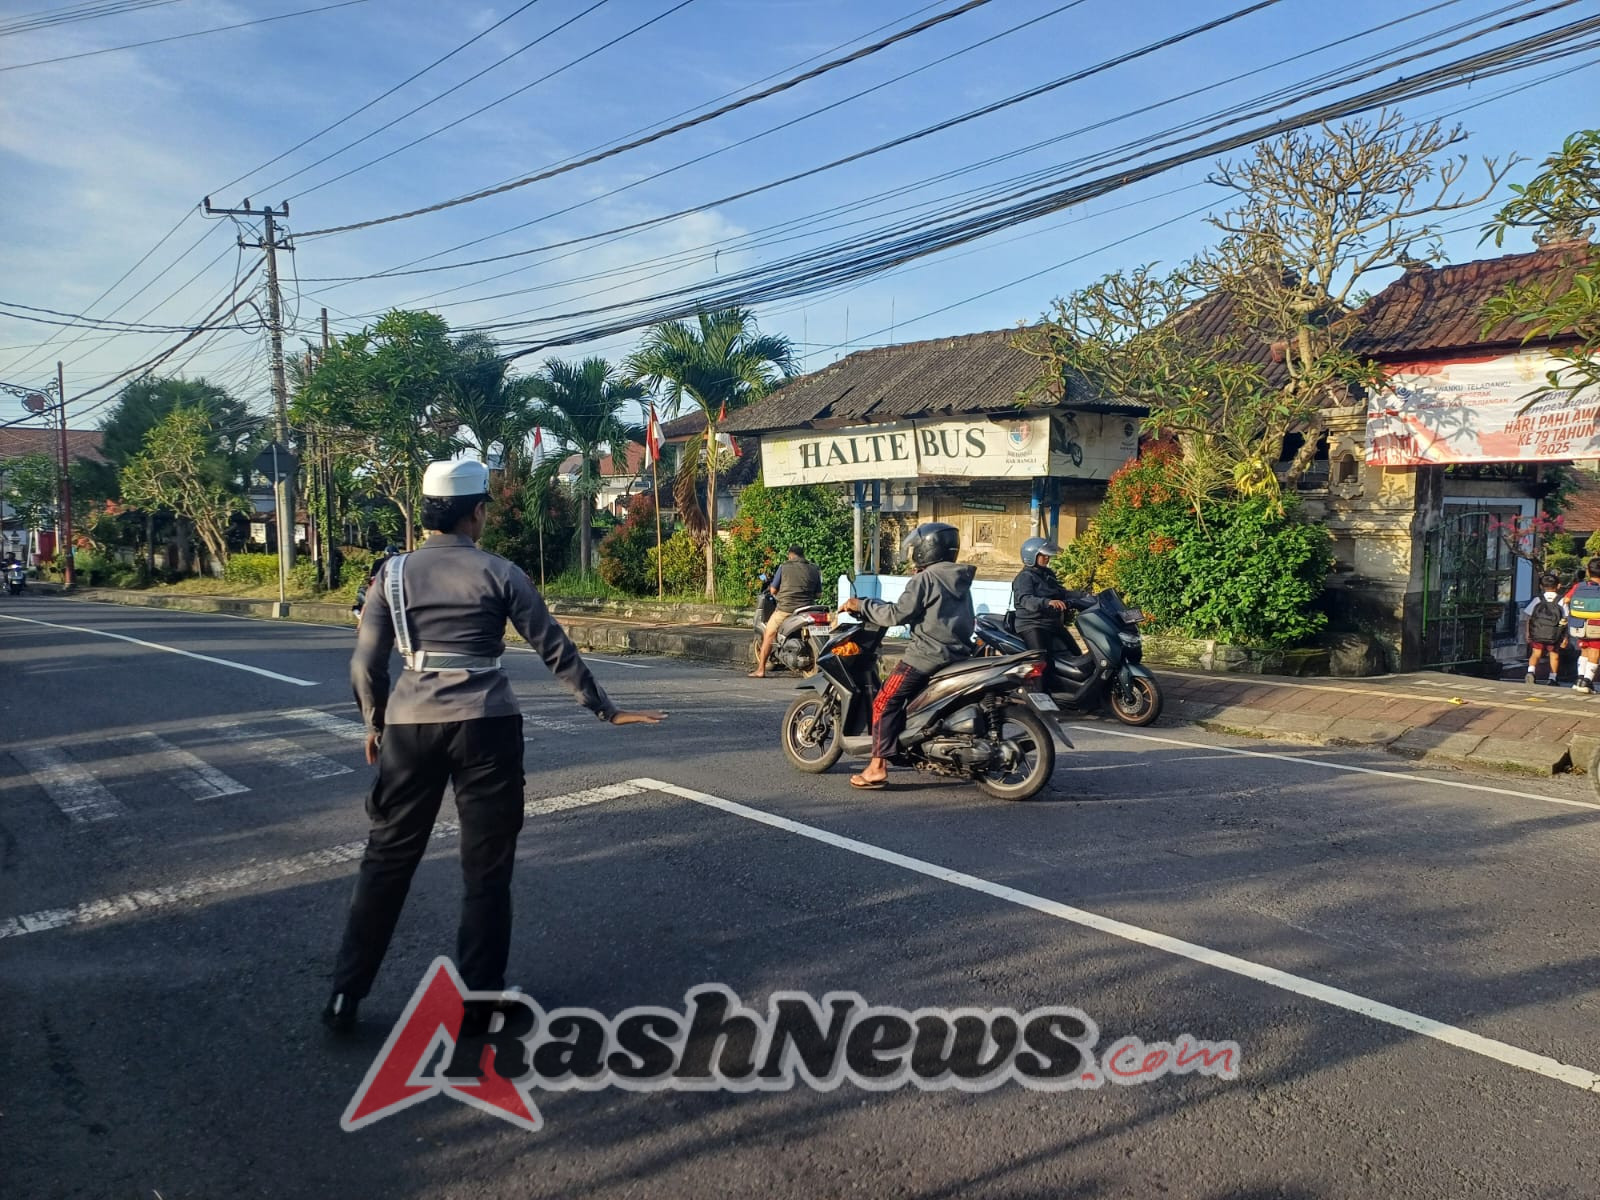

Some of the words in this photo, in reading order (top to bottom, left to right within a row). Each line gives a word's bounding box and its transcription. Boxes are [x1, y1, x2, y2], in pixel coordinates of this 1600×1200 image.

[1504, 416, 1536, 434] HARI
[1538, 405, 1600, 429] PAHLAWA
[1517, 432, 1533, 446] KE
[1535, 430, 1549, 444] 79
[1553, 423, 1596, 441] TAHUN
[799, 433, 910, 469] HALTE
[920, 427, 986, 458] BUS
[1541, 441, 1570, 455] 2025
